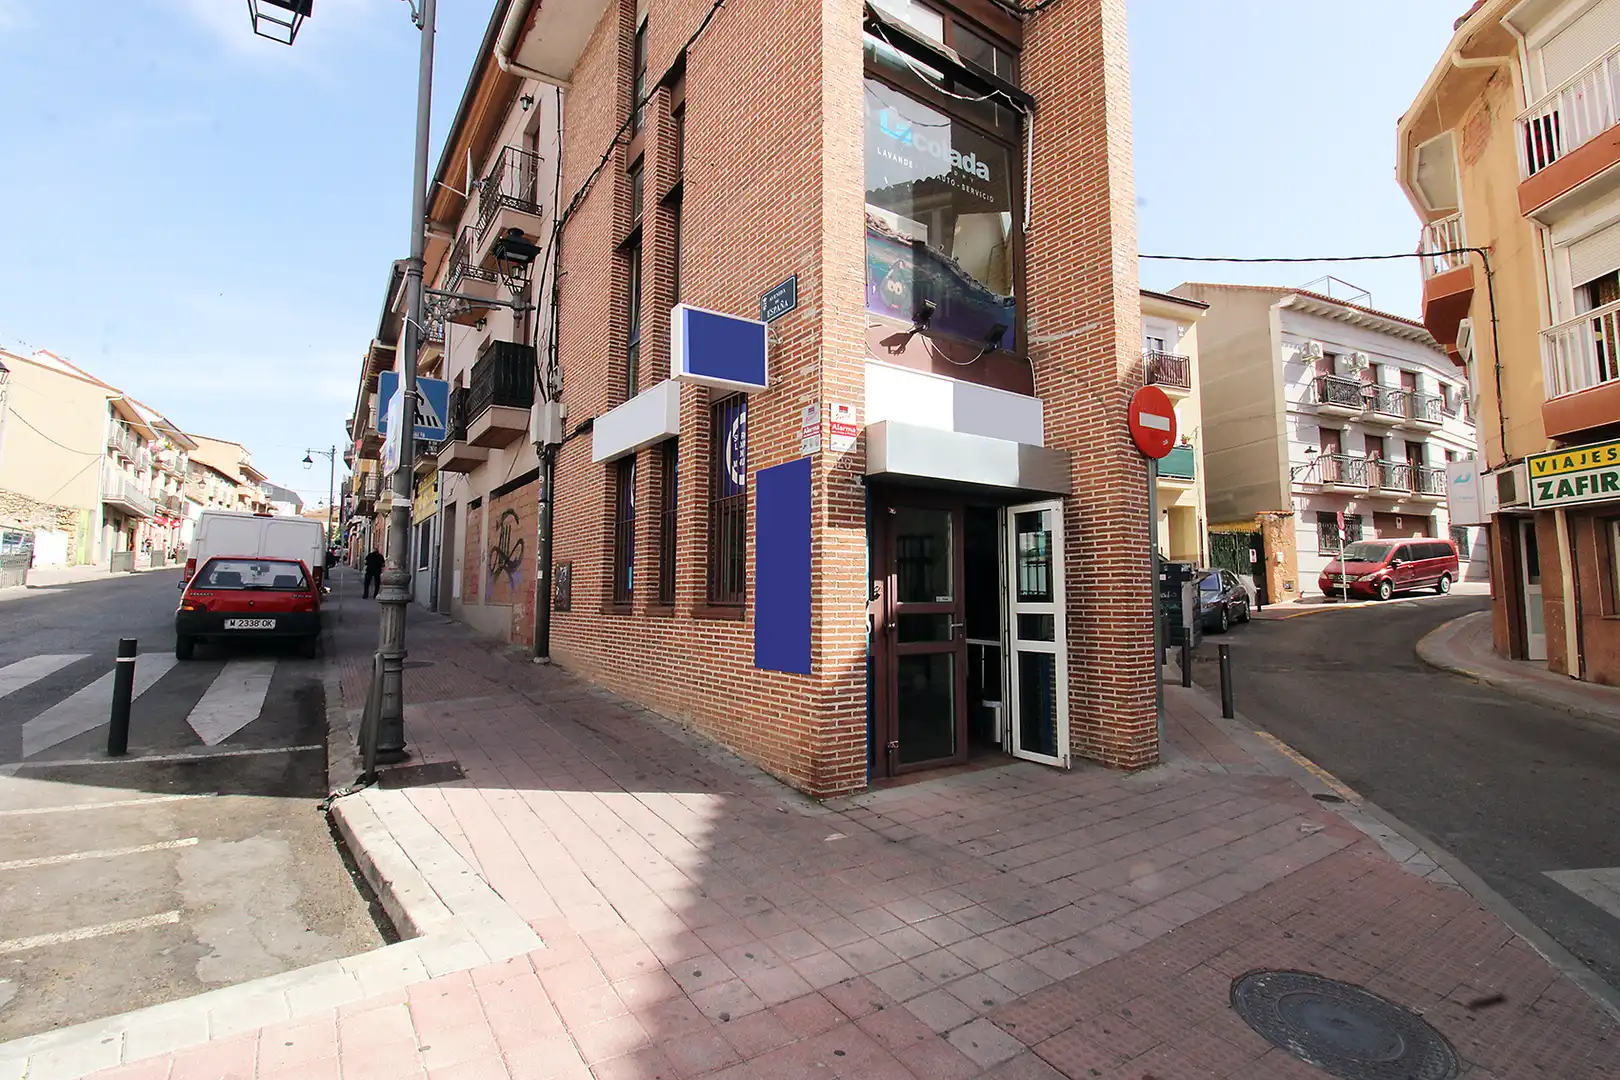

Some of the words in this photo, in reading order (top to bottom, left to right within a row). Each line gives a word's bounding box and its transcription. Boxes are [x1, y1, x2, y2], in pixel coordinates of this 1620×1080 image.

[767, 299, 789, 318] ESPAÑA
[803, 425, 820, 434] Alarma
[832, 423, 856, 433] Alarma
[1536, 448, 1618, 472] VIAJES
[238, 619, 259, 627] 2338
[261, 619, 273, 627] OK
